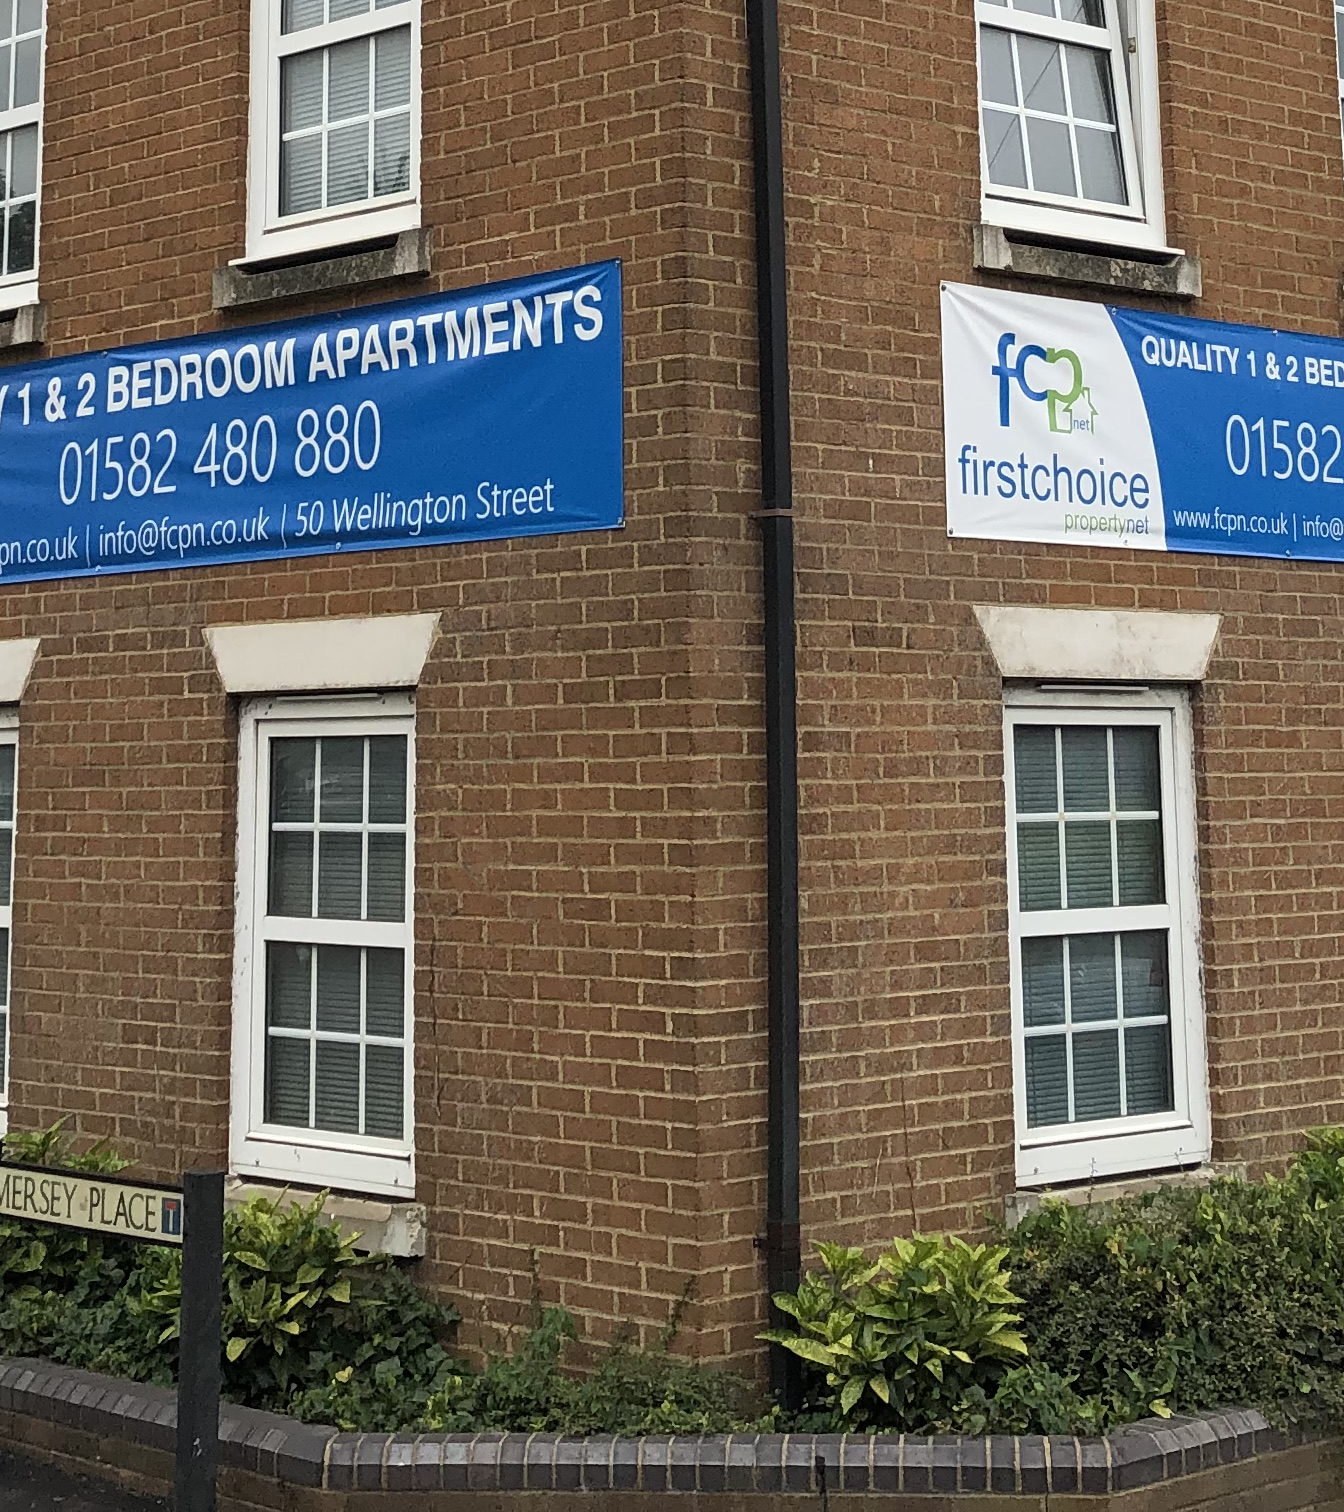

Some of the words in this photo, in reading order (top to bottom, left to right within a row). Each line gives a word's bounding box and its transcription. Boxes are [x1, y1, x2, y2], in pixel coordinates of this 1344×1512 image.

[17, 382, 31, 426] 1
[44, 376, 67, 423] &
[76, 372, 97, 418] 2
[106, 337, 297, 413] BEDROOM
[308, 284, 603, 383] APARTMENTS
[1141, 335, 1240, 375] QUALITY
[1246, 350, 1257, 378] 1
[1265, 352, 1282, 381] &
[1285, 355, 1300, 383] 2
[1073, 417, 1090, 431] net
[1225, 414, 1344, 485] 01582
[59, 428, 177, 506] 01582
[193, 414, 278, 488] 480
[294, 400, 381, 478] 880
[957, 444, 1150, 509] firstchoice
[99, 506, 270, 559] info@fcpn.co.uk
[294, 499, 325, 538] 50
[332, 490, 467, 536] Wellington
[475, 477, 555, 520] Street
[1064, 513, 1149, 538] propertynet
[1172, 506, 1289, 537] www.fcpn.co.uk
[88, 1186, 157, 1233] PLACE
